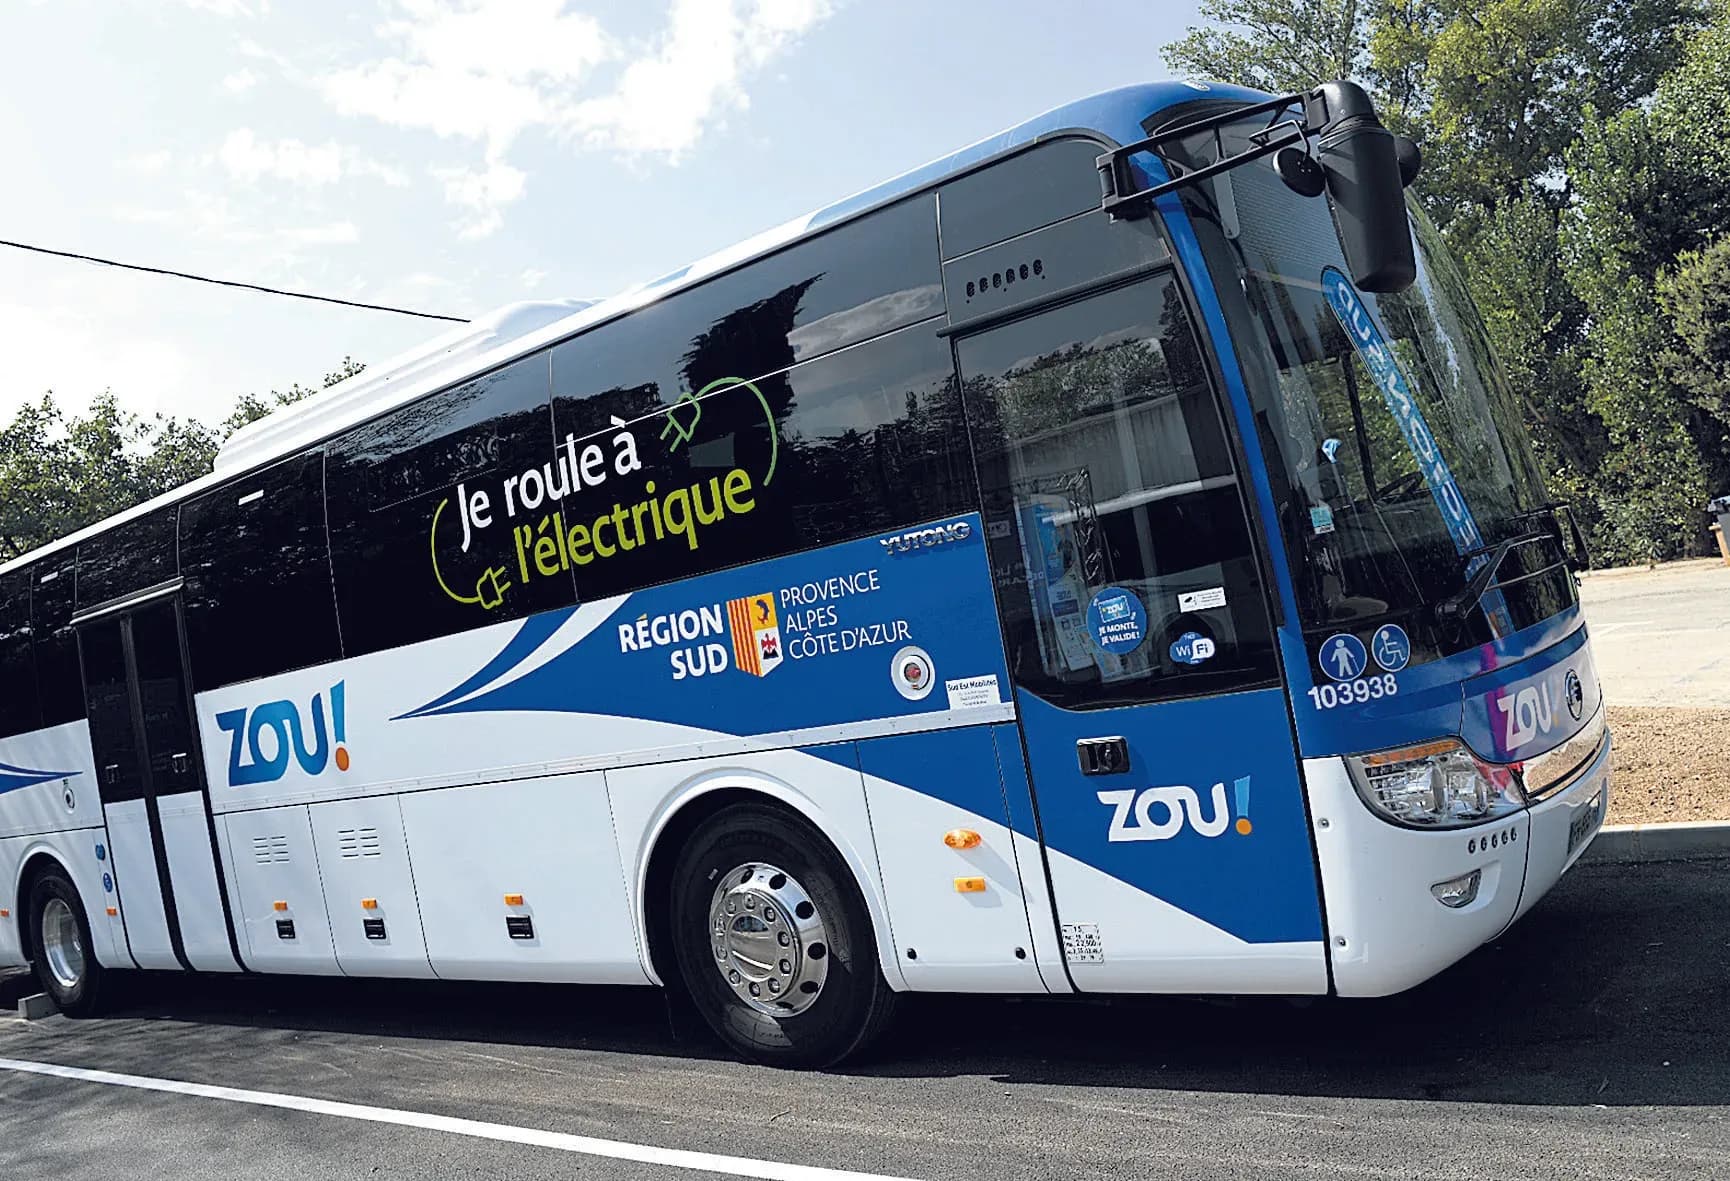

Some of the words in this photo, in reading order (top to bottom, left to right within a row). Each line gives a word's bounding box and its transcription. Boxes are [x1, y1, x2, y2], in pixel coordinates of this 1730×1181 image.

[458, 483, 492, 552] Je
[503, 433, 606, 517] roule
[611, 414, 642, 476] à
[513, 468, 755, 584] l'électrique
[879, 521, 971, 556] YUTONG
[780, 569, 880, 608] PROVENCE
[618, 604, 724, 653] RÉGION
[785, 606, 838, 633] ALPES
[788, 632, 839, 659] CÔTE
[842, 620, 912, 644] D'AZUR
[670, 643, 728, 680] SUD
[1309, 674, 1398, 710] 103938
